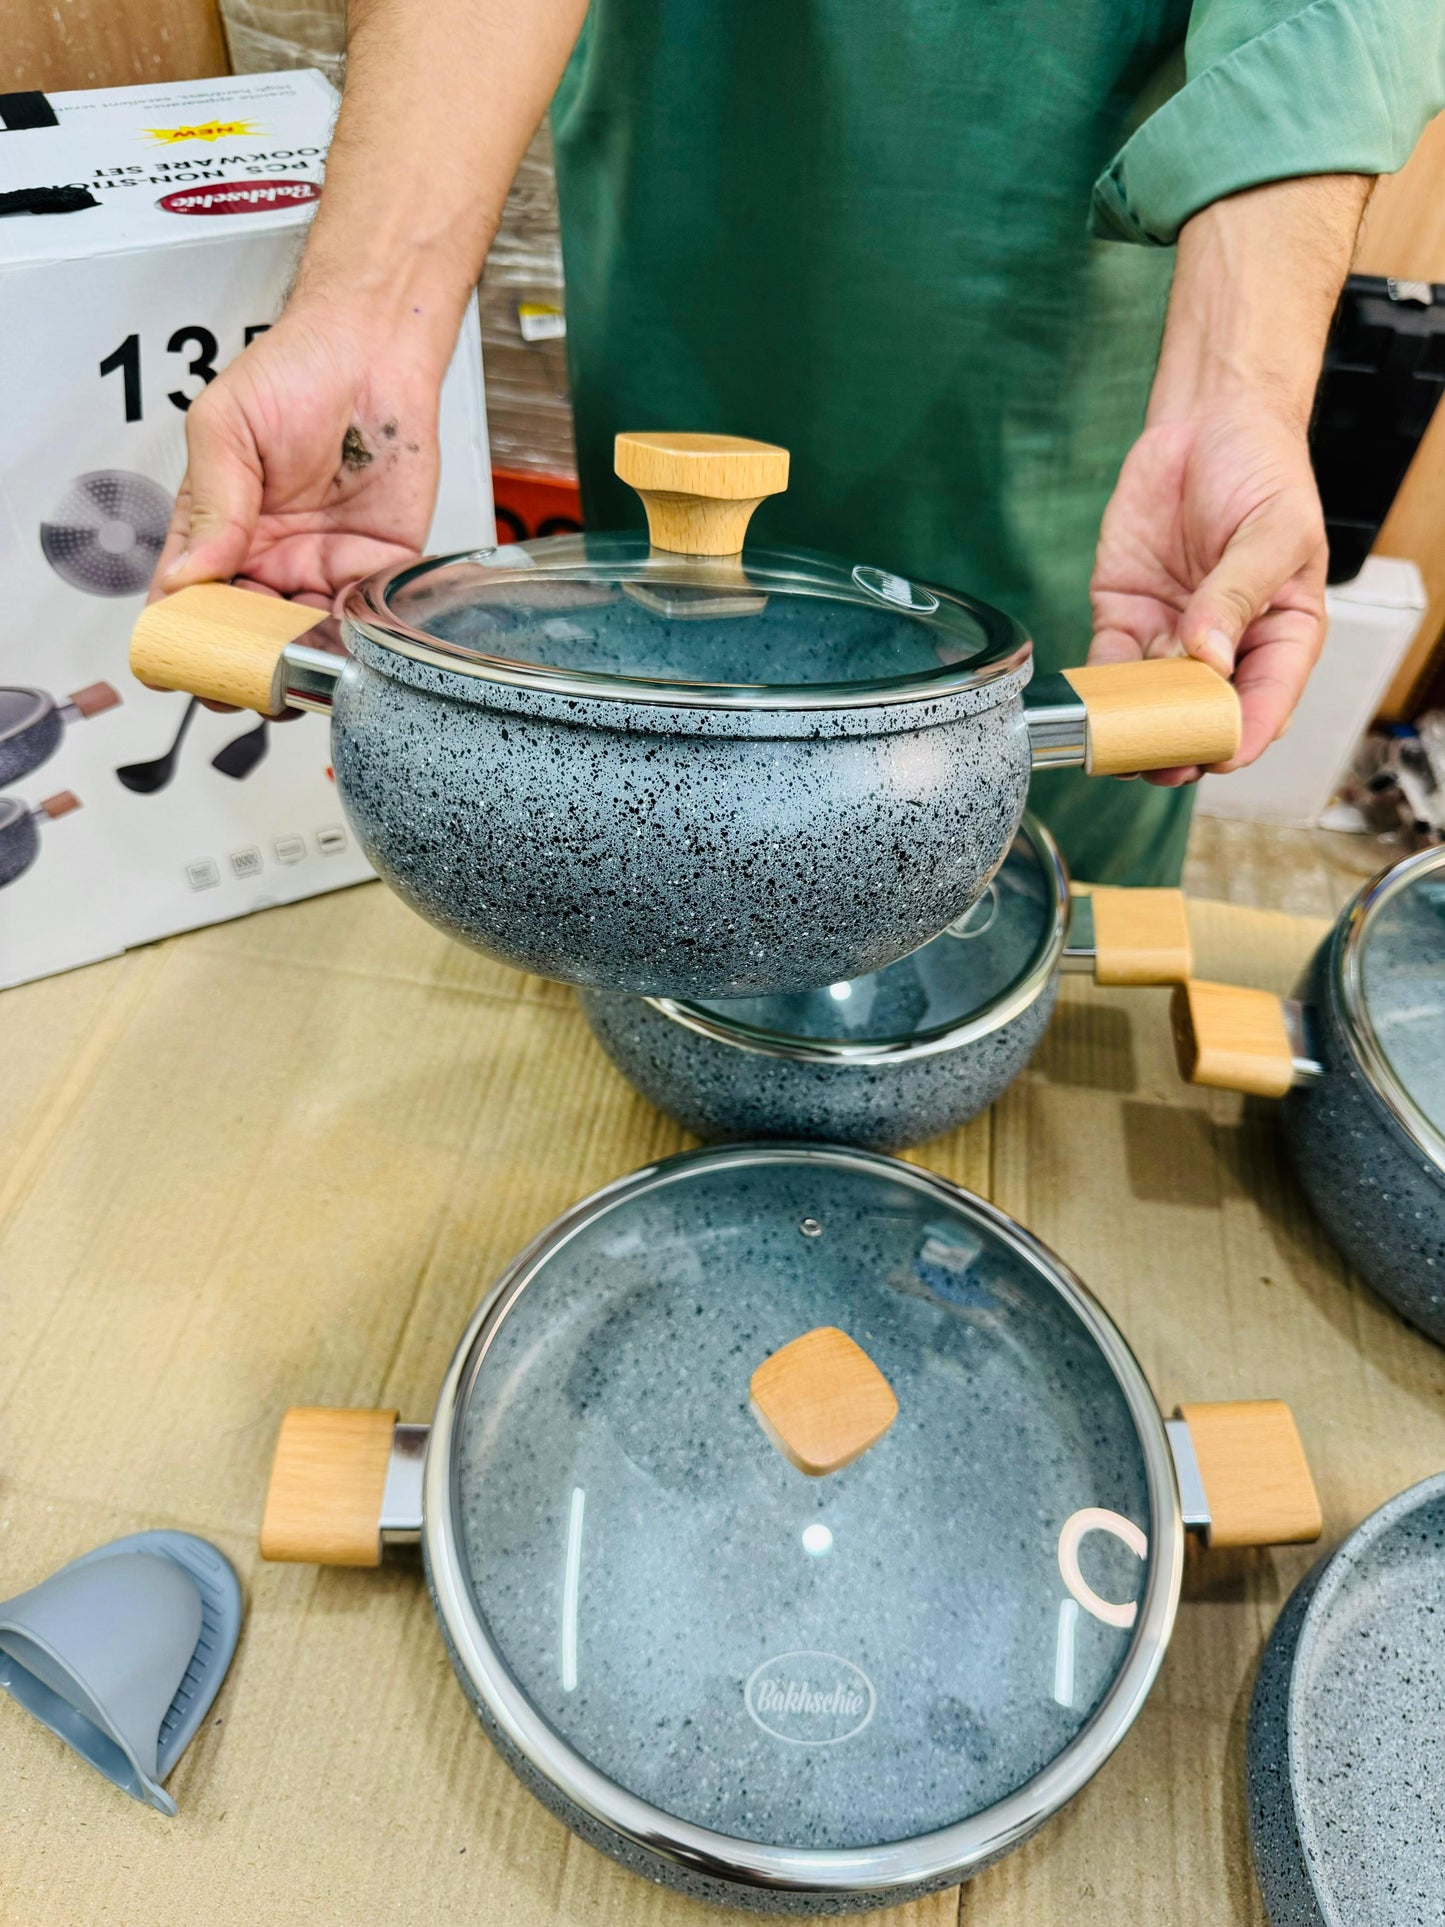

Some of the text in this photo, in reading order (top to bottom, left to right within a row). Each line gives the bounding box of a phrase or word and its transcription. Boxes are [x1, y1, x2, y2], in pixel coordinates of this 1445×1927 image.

[172, 125, 235, 139] NEW
[92, 146, 329, 178] OOKWARE SET
[245, 160, 310, 175] PCS
[170, 183, 316, 209] Bakhschie
[757, 1680, 864, 1716] Bakhschie
